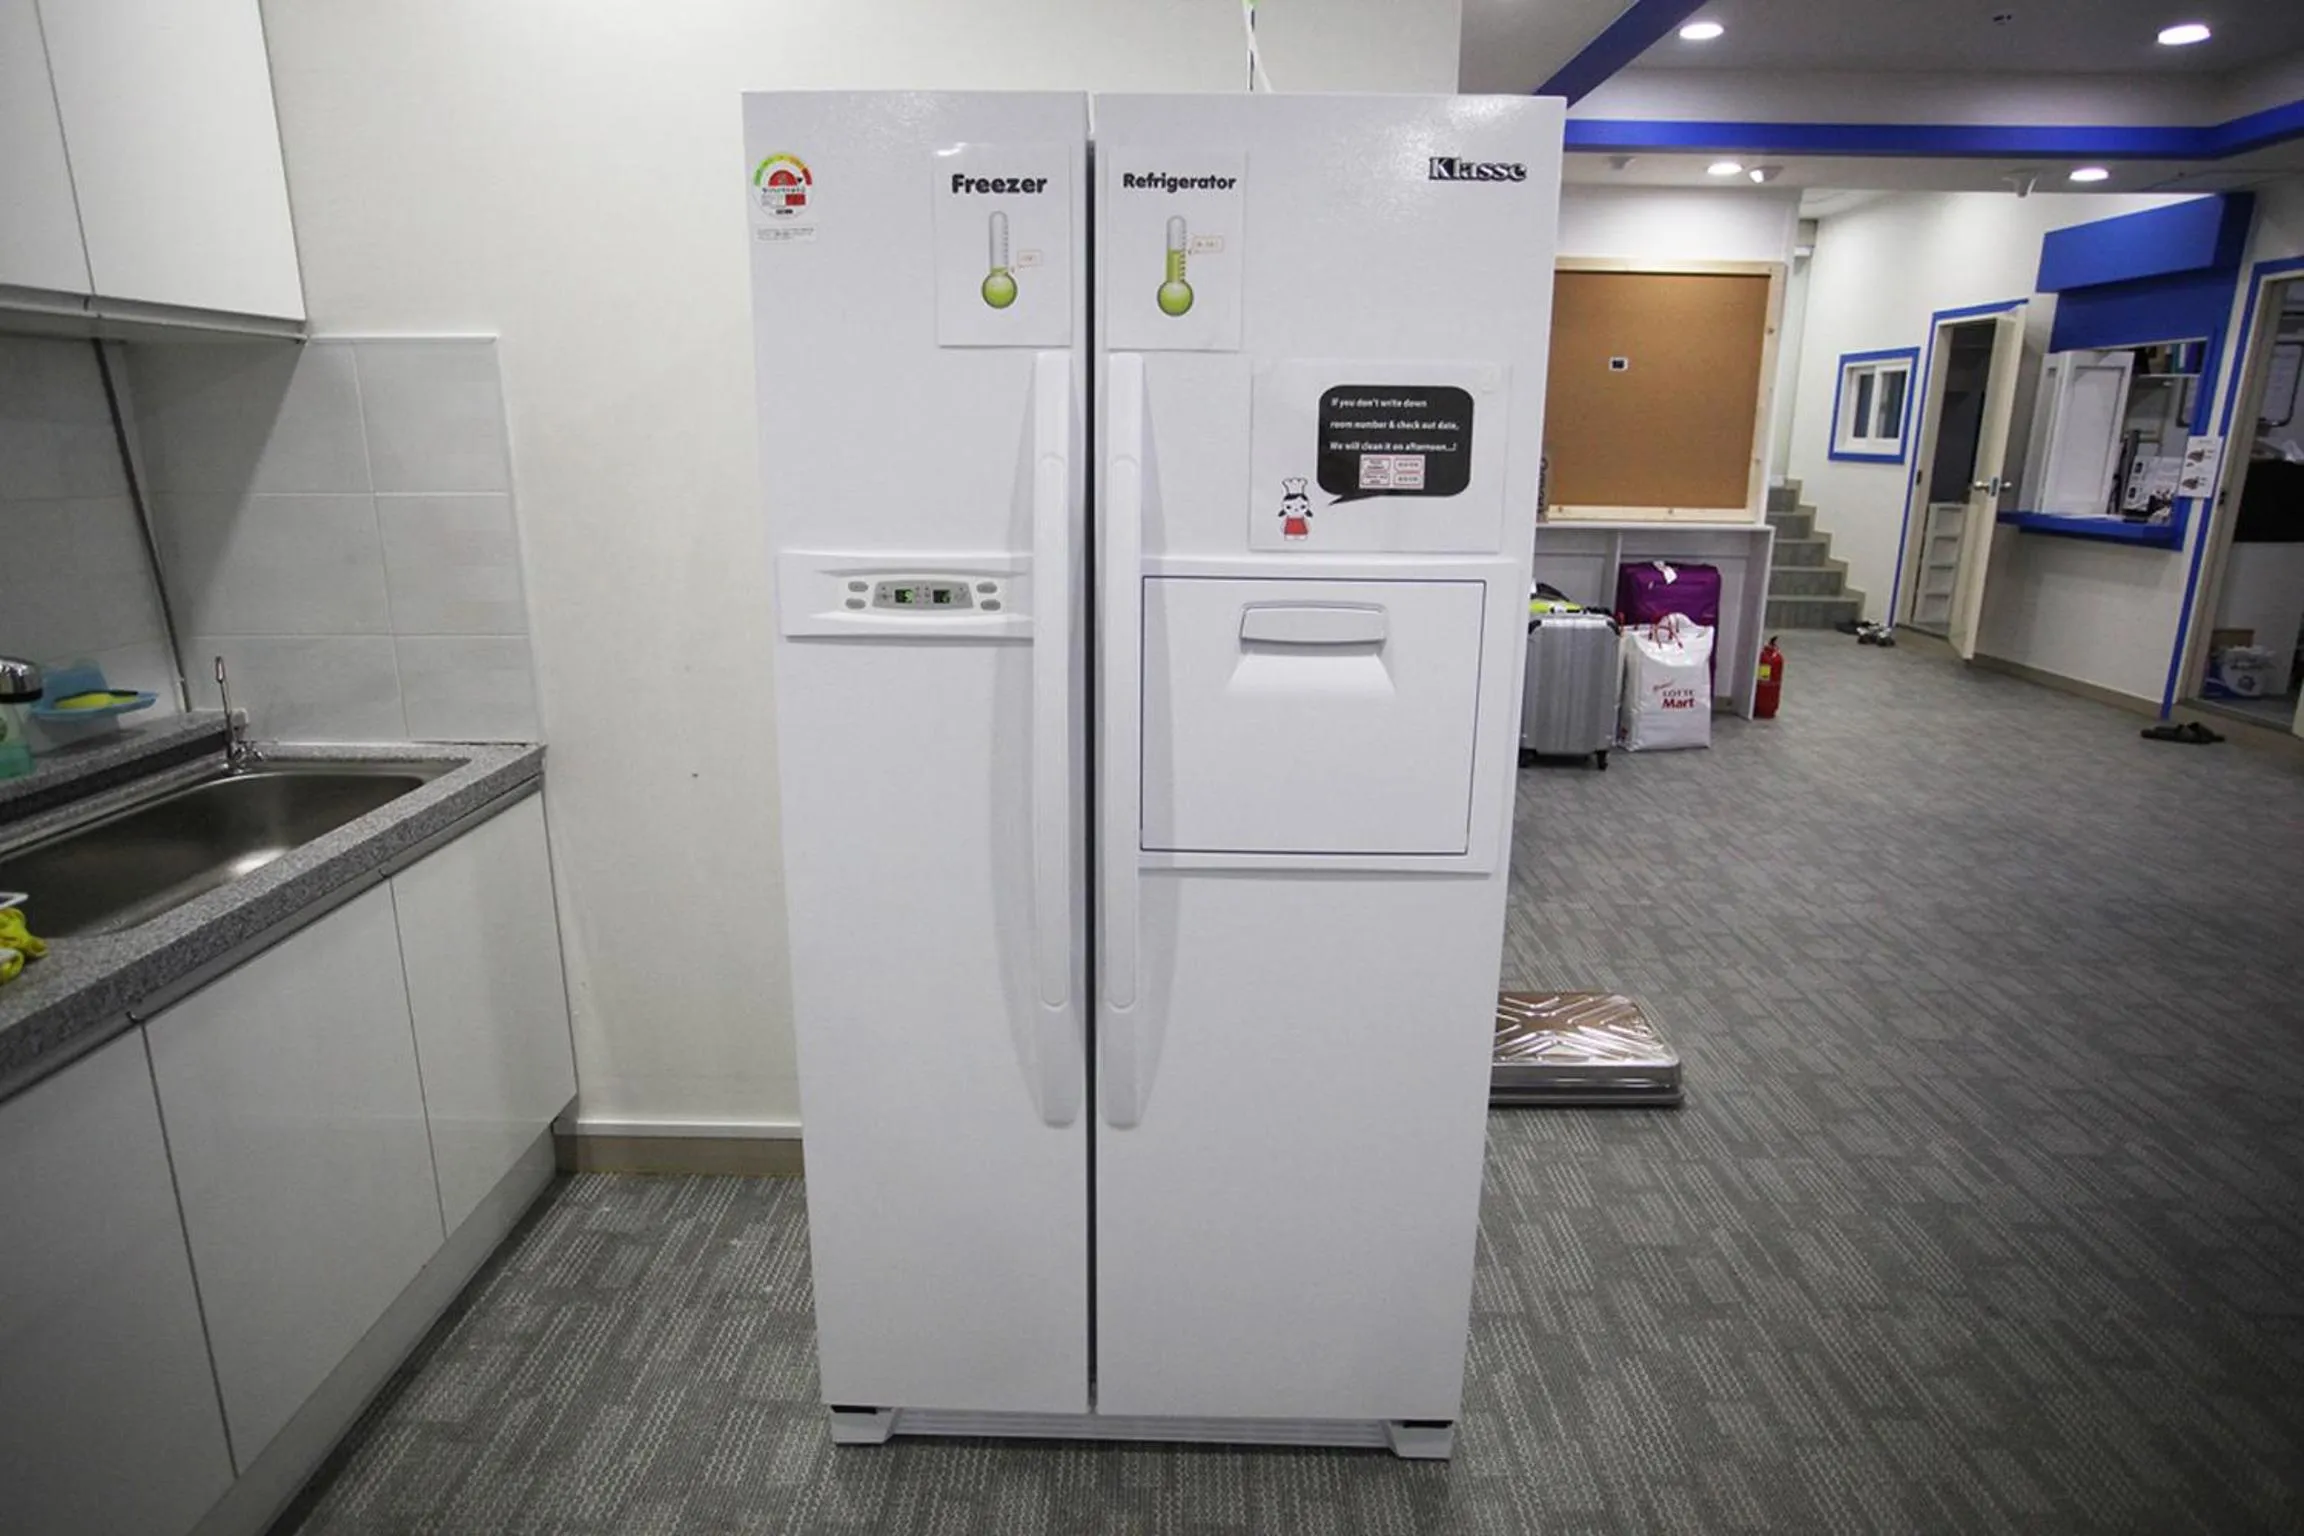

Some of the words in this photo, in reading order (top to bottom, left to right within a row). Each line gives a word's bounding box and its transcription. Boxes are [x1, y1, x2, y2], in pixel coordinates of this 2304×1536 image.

[1429, 157, 1526, 182] Klasse
[952, 173, 1047, 194] Freezer
[1123, 172, 1236, 193] Refrigerator
[1331, 397, 1340, 407] If
[1340, 400, 1355, 409] you
[1356, 398, 1379, 408] don't
[1380, 398, 1402, 407] write
[1403, 399, 1428, 408] down
[1330, 421, 1353, 429] room
[1355, 420, 1387, 429] number
[1388, 420, 1395, 429] &
[1396, 420, 1420, 430] check
[1421, 420, 1436, 429] out
[1330, 441, 1343, 450] We
[1344, 441, 1360, 450] will
[1361, 442, 1383, 451] clean
[1383, 442, 1392, 450] it
[1661, 698, 1694, 709] Mart
